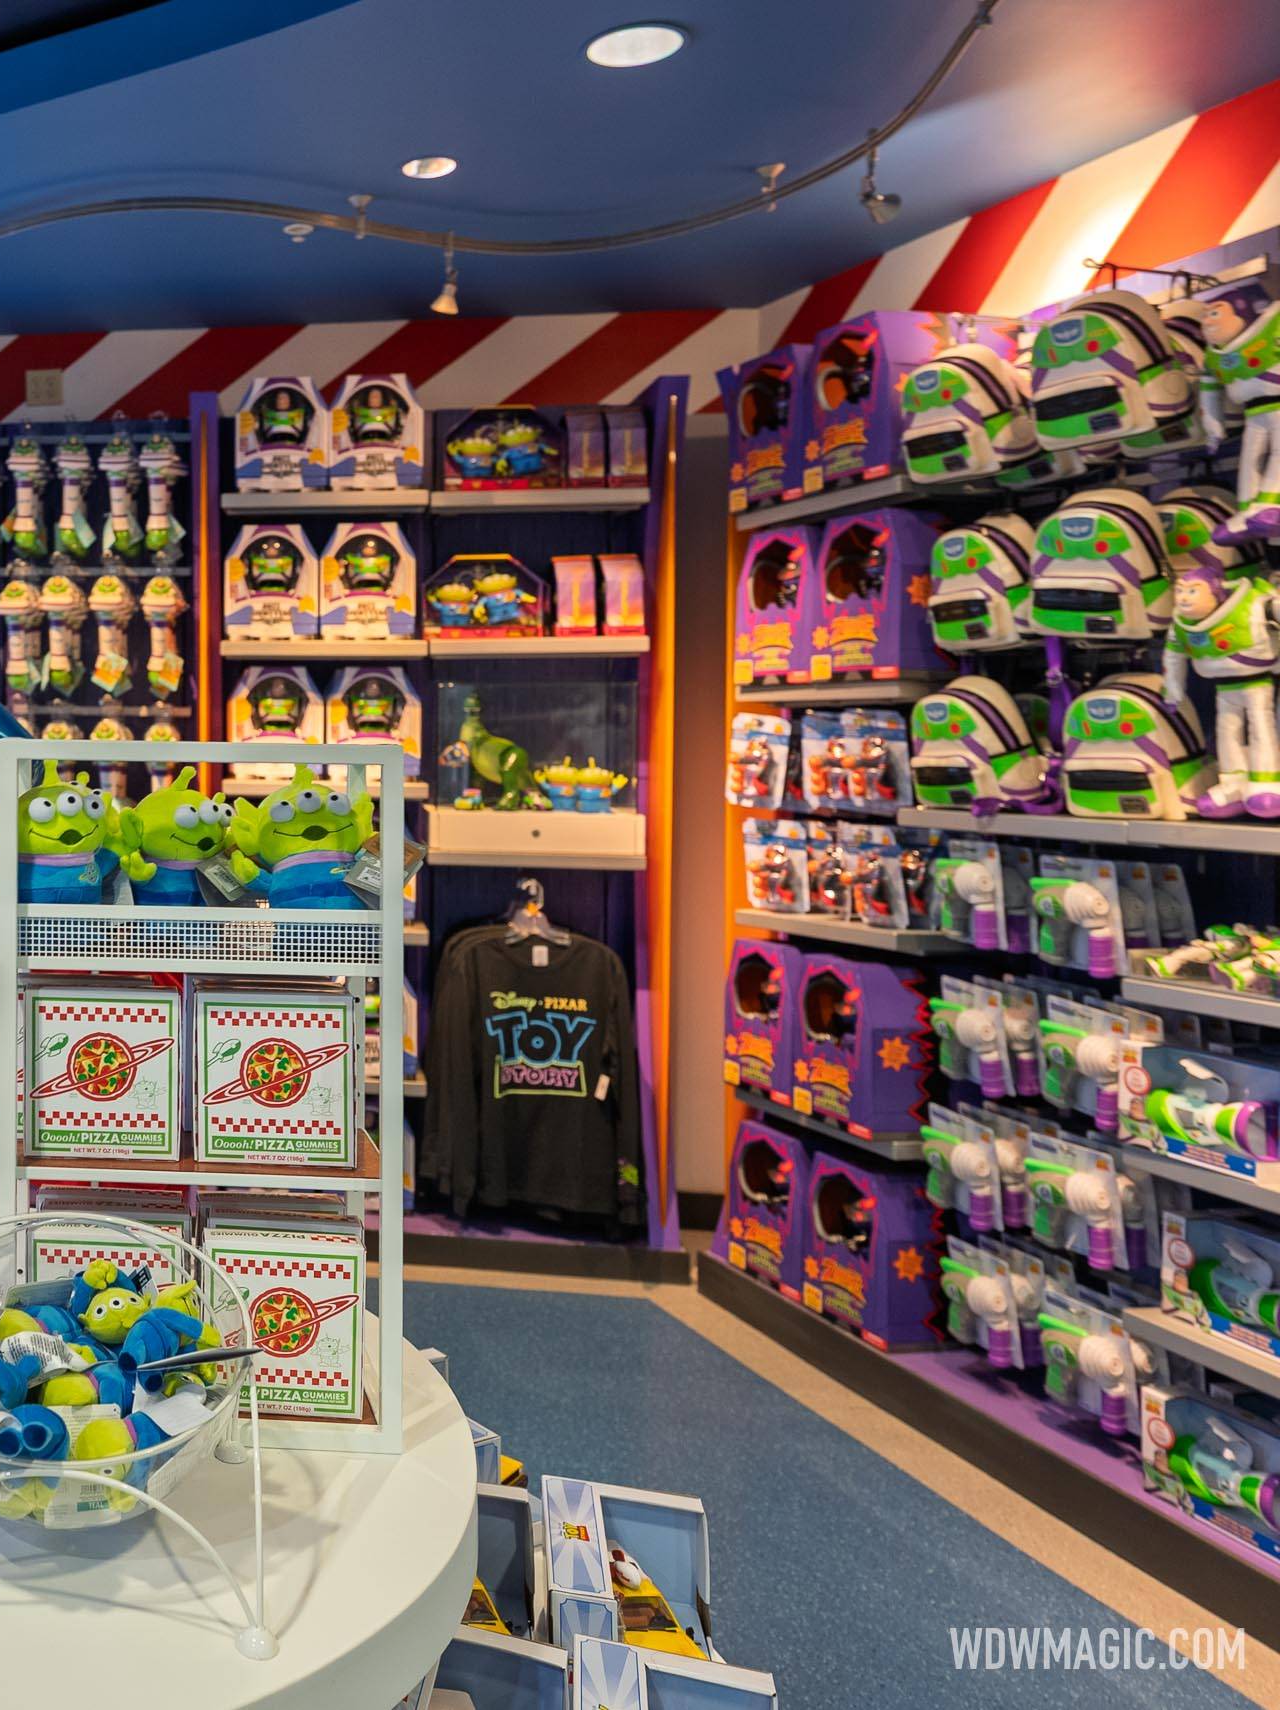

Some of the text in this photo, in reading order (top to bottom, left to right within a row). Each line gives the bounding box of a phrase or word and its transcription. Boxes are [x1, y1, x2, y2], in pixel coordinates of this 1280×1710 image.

[490, 991, 588, 1012] Disney PIXAR
[485, 1011, 597, 1064] TOY
[502, 1066, 579, 1089] STORY
[41, 1131, 162, 1144] Ooooh! PIZZA GUMMIES
[214, 1138, 253, 1149] Ooooh!
[255, 1139, 295, 1151] PIZZA
[296, 1140, 338, 1149] GUMMIES
[260, 1232, 306, 1240] PIZZA
[261, 1388, 301, 1401] PIZZA
[303, 1391, 345, 1401] GUMMIES
